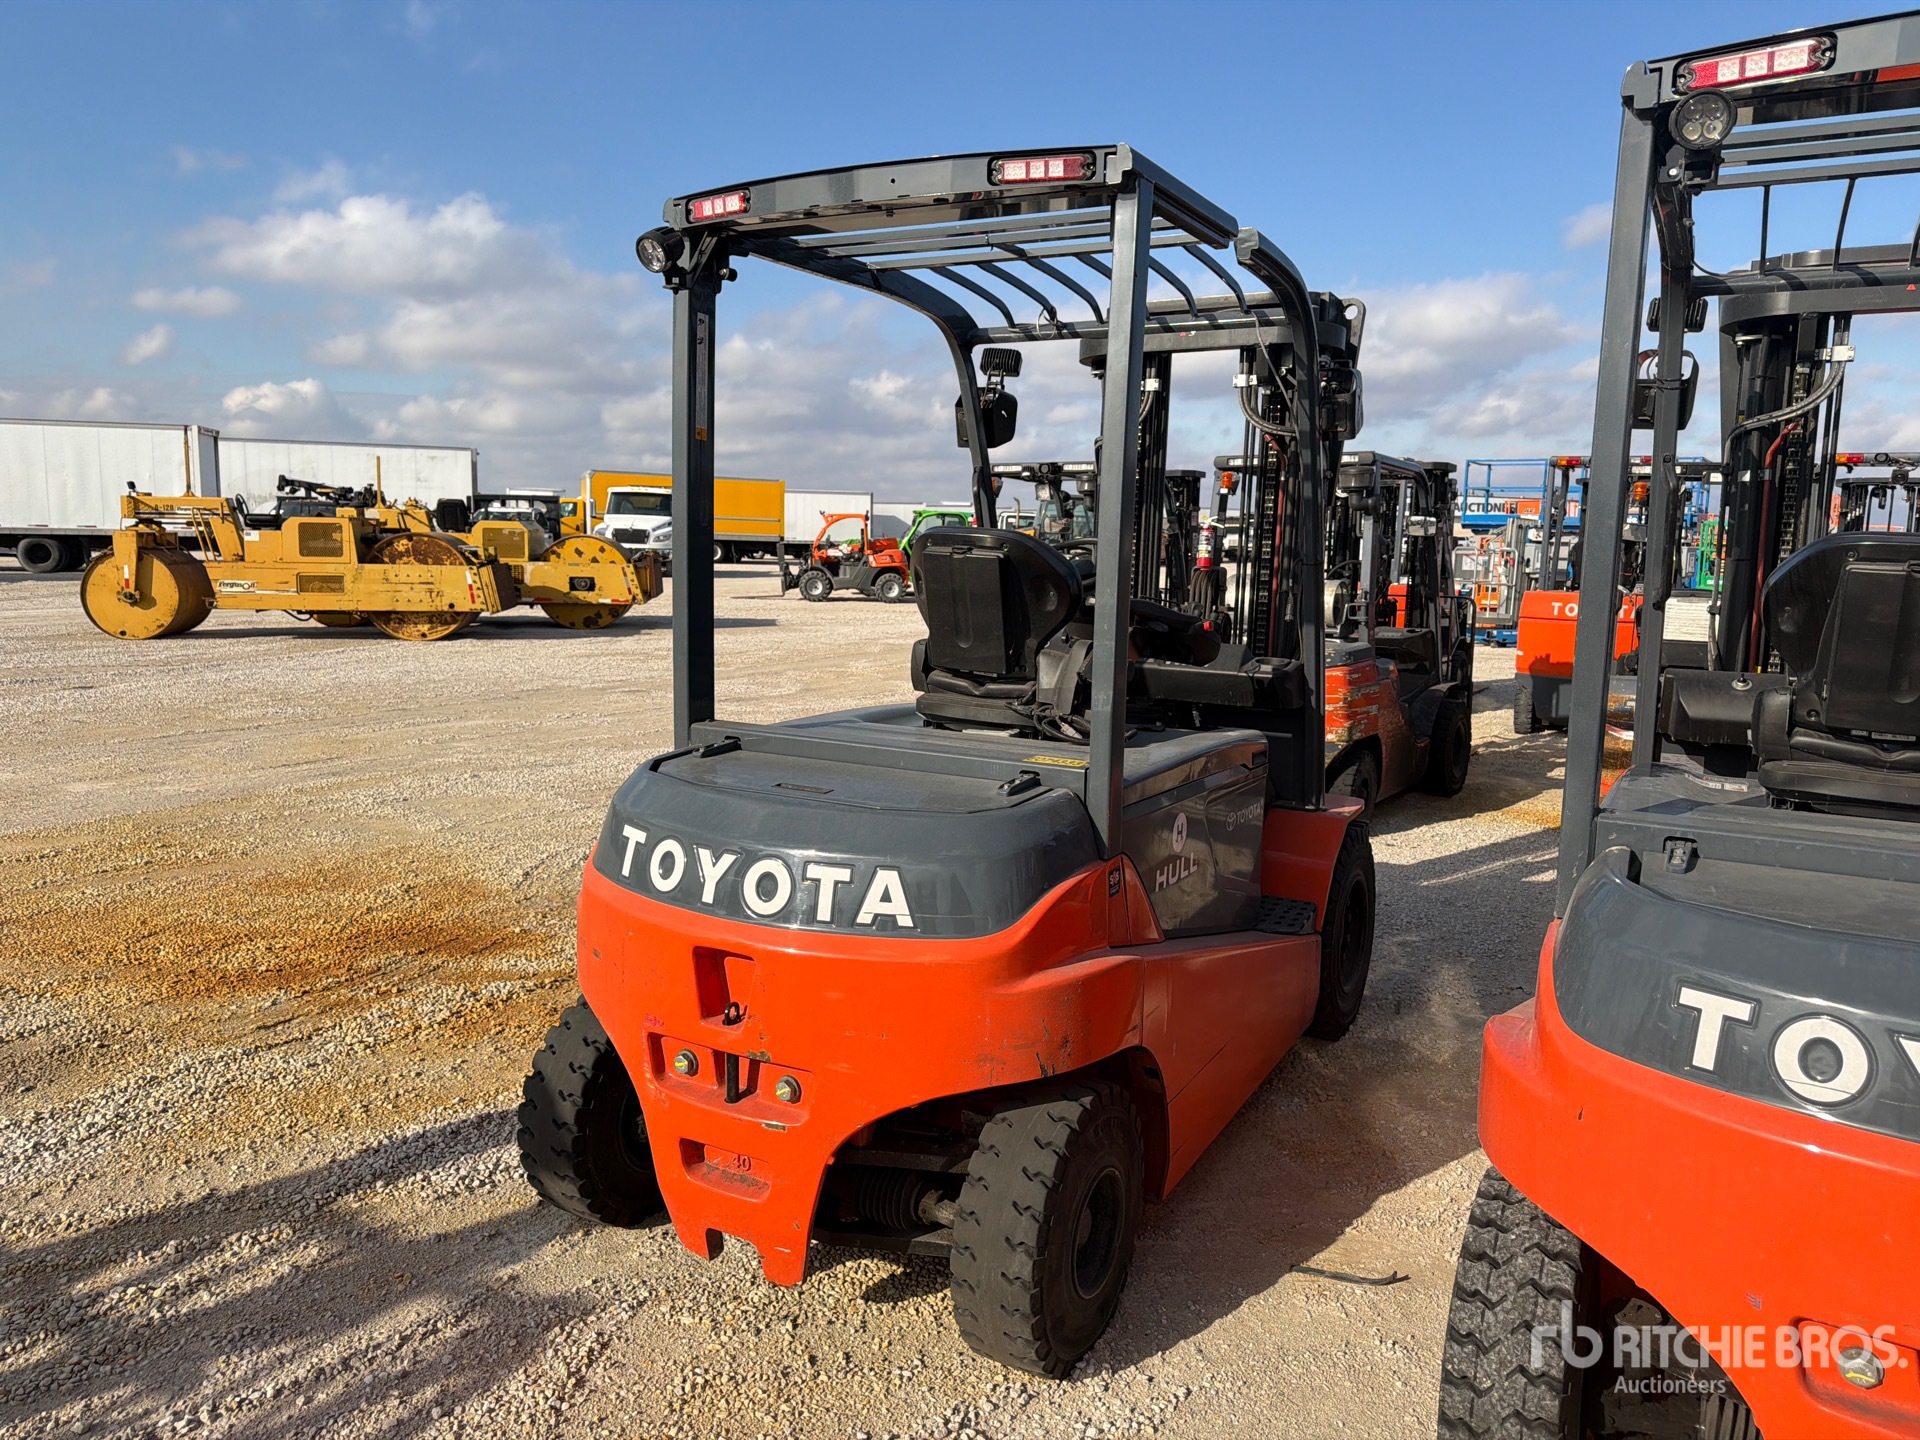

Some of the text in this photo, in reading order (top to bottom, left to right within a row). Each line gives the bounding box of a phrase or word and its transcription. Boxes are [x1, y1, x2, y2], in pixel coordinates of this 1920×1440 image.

[1236, 802, 1261, 825] TOYOTA
[621, 824, 914, 927] TOYOTA
[1155, 852, 1198, 892] HULL
